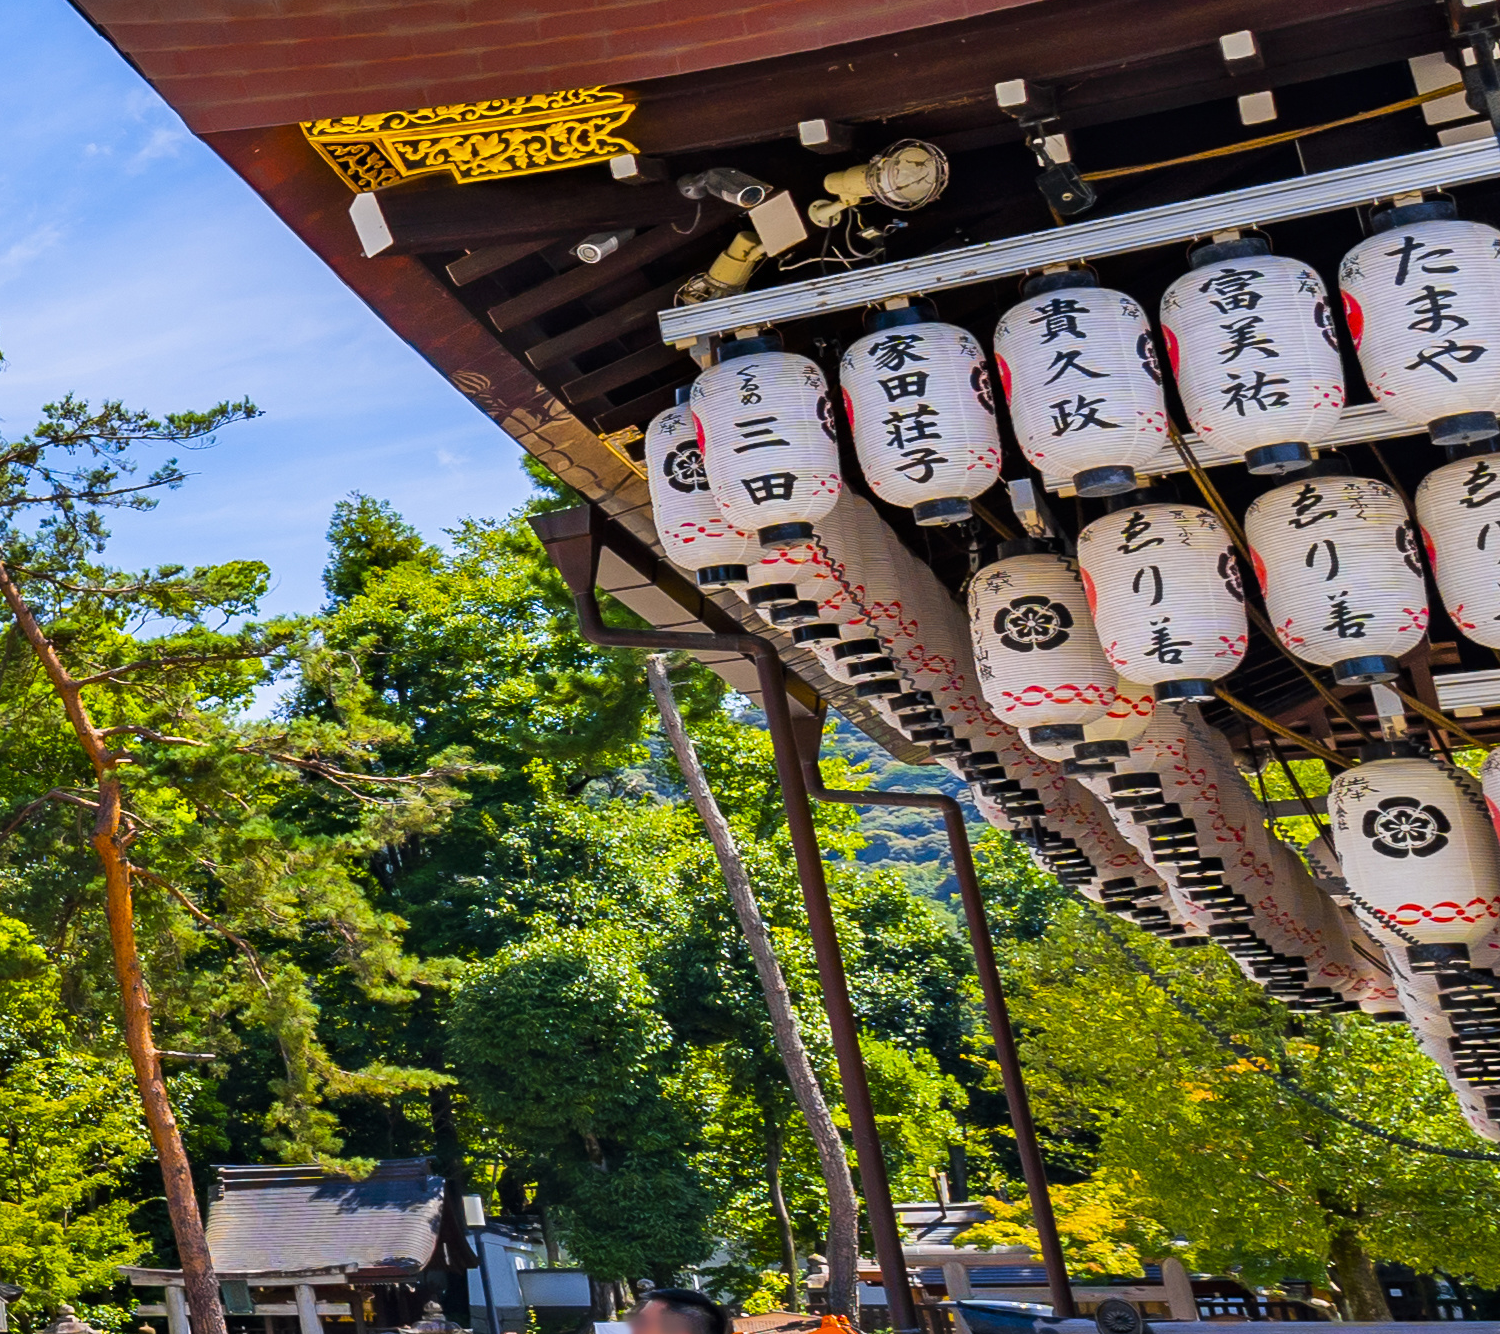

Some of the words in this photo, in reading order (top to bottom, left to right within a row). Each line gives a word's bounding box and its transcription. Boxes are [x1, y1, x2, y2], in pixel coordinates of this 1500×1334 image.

[1029, 298, 1123, 437] 貴久政
[1199, 268, 1290, 416] 富美祐
[1385, 236, 1488, 383] たまや
[733, 416, 798, 505] 三田
[868, 334, 948, 483] 家田荘子
[1117, 510, 1192, 664] ゑり善
[1288, 484, 1374, 638] ゑり善
